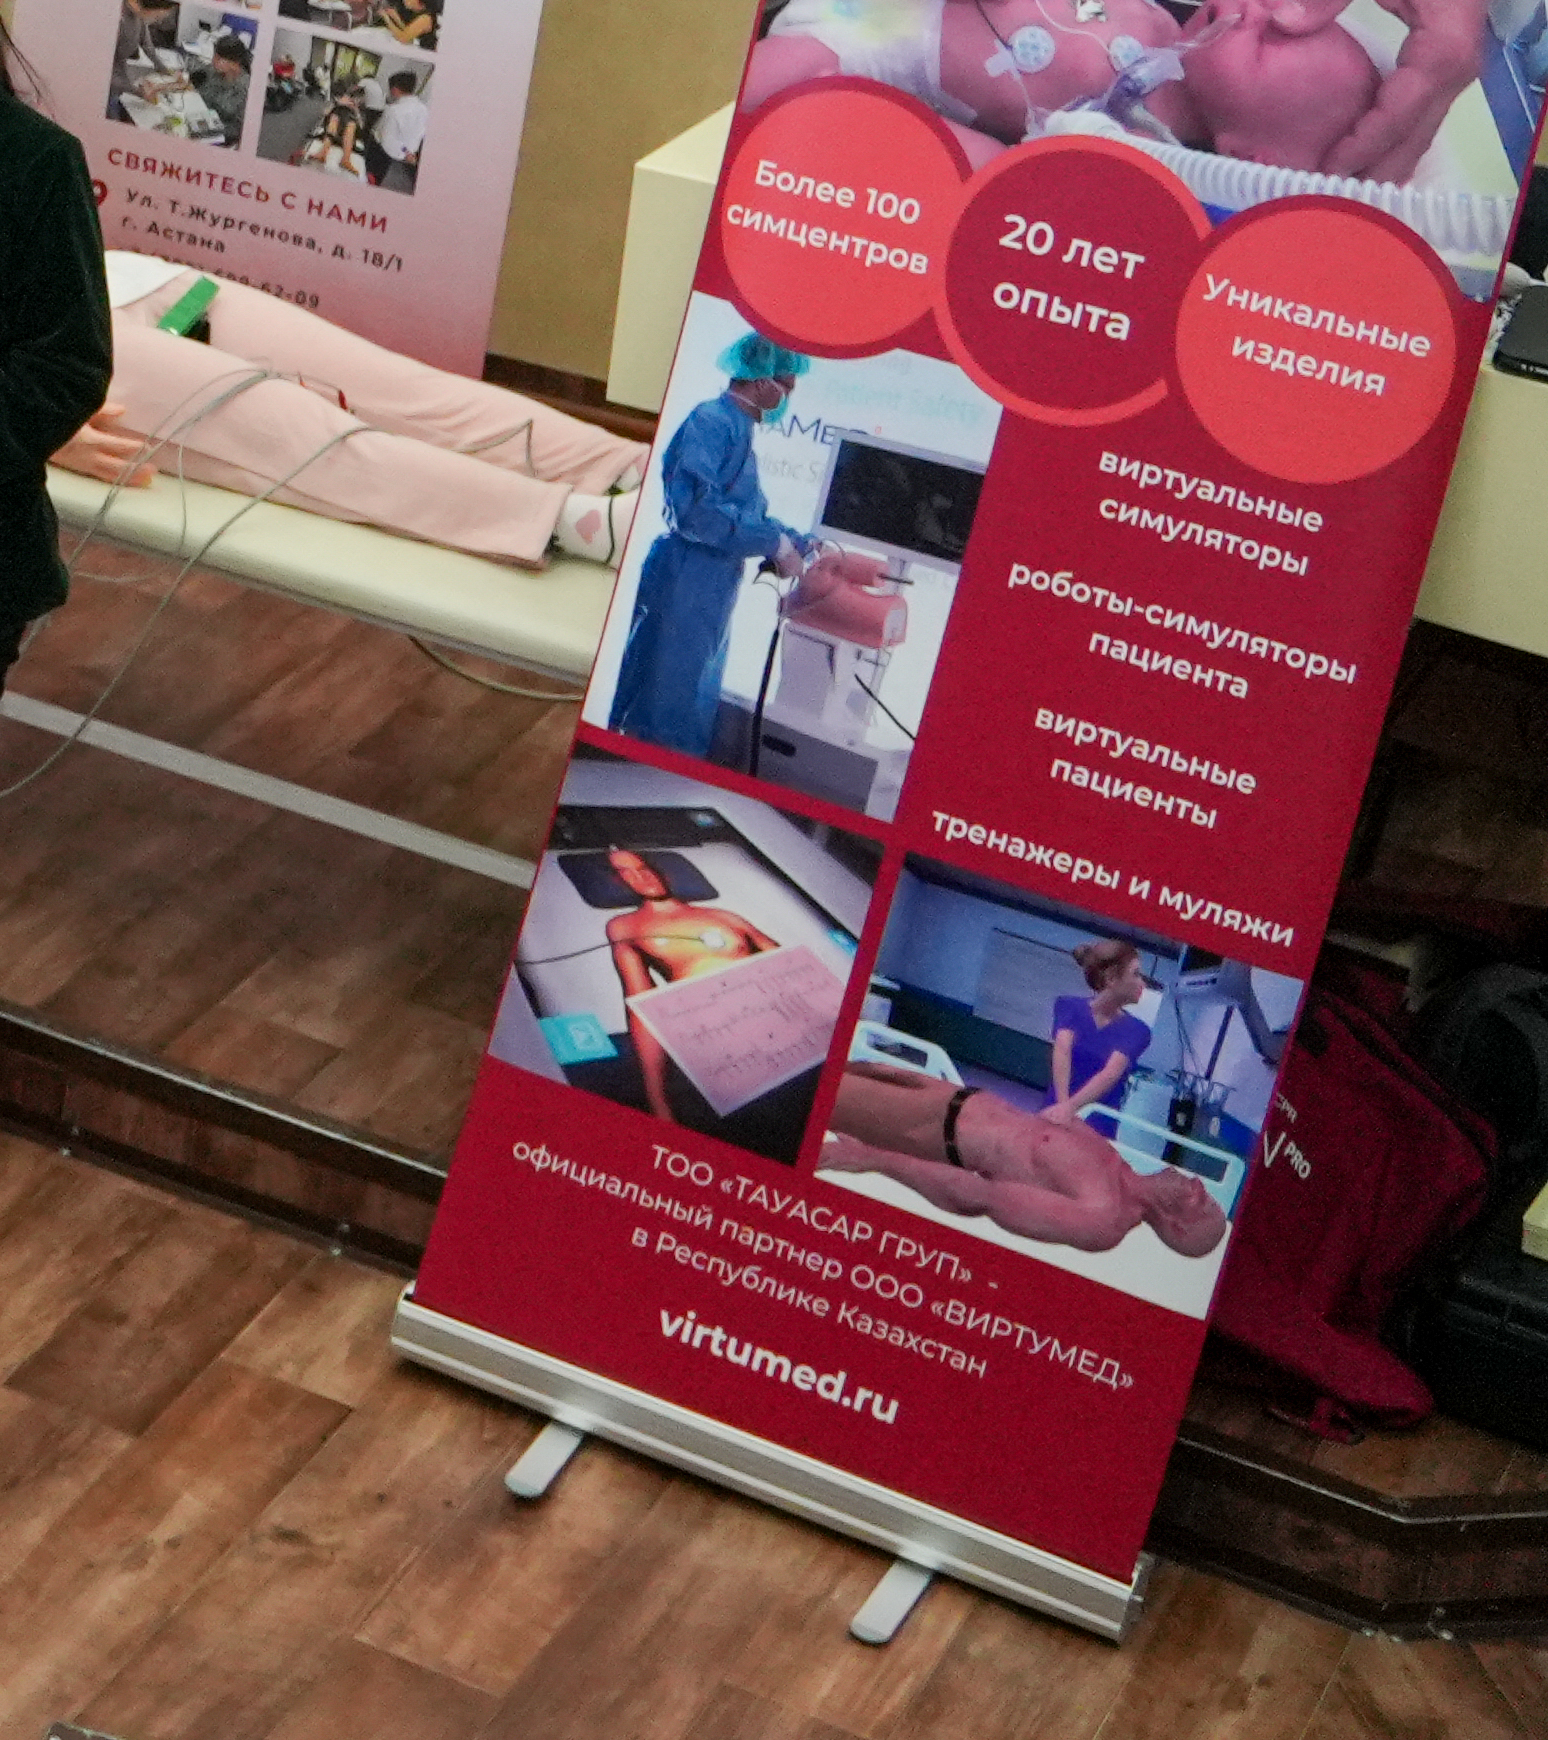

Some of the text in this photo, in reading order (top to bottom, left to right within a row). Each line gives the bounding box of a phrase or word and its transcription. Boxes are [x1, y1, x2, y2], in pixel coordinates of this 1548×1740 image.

[108, 147, 388, 234] СВЯЖИТЕСЬ С НАМИ
[753, 159, 922, 225] Более 100
[146, 220, 226, 253] Астана
[726, 199, 929, 275] симцентров
[997, 213, 1146, 282] 20 лет
[992, 279, 1132, 342] опыта
[1203, 273, 1432, 359] Уникальные
[1231, 333, 1387, 397] изделия
[1098, 450, 1324, 533] виртуальные
[1099, 498, 1309, 576] симуляторы
[1008, 563, 1357, 685] роботы-симуляторы
[1088, 632, 1250, 699] пациента
[1035, 707, 1258, 795] виртуальные
[1051, 758, 1217, 830] пациенты
[931, 809, 1295, 948] тренажеры и муляжи
[1284, 1140, 1312, 1179] PRO
[651, 1144, 714, 1189] ТОО
[720, 1175, 874, 1246] «ТАУАСАР
[879, 1230, 973, 1284] ГРУП»
[512, 1138, 1135, 1391] официальный партнер ООО «ВИРТУМЕД»
[630, 1225, 988, 1381] в Республике Казахстан
[659, 1305, 901, 1426] virtumed.ru
